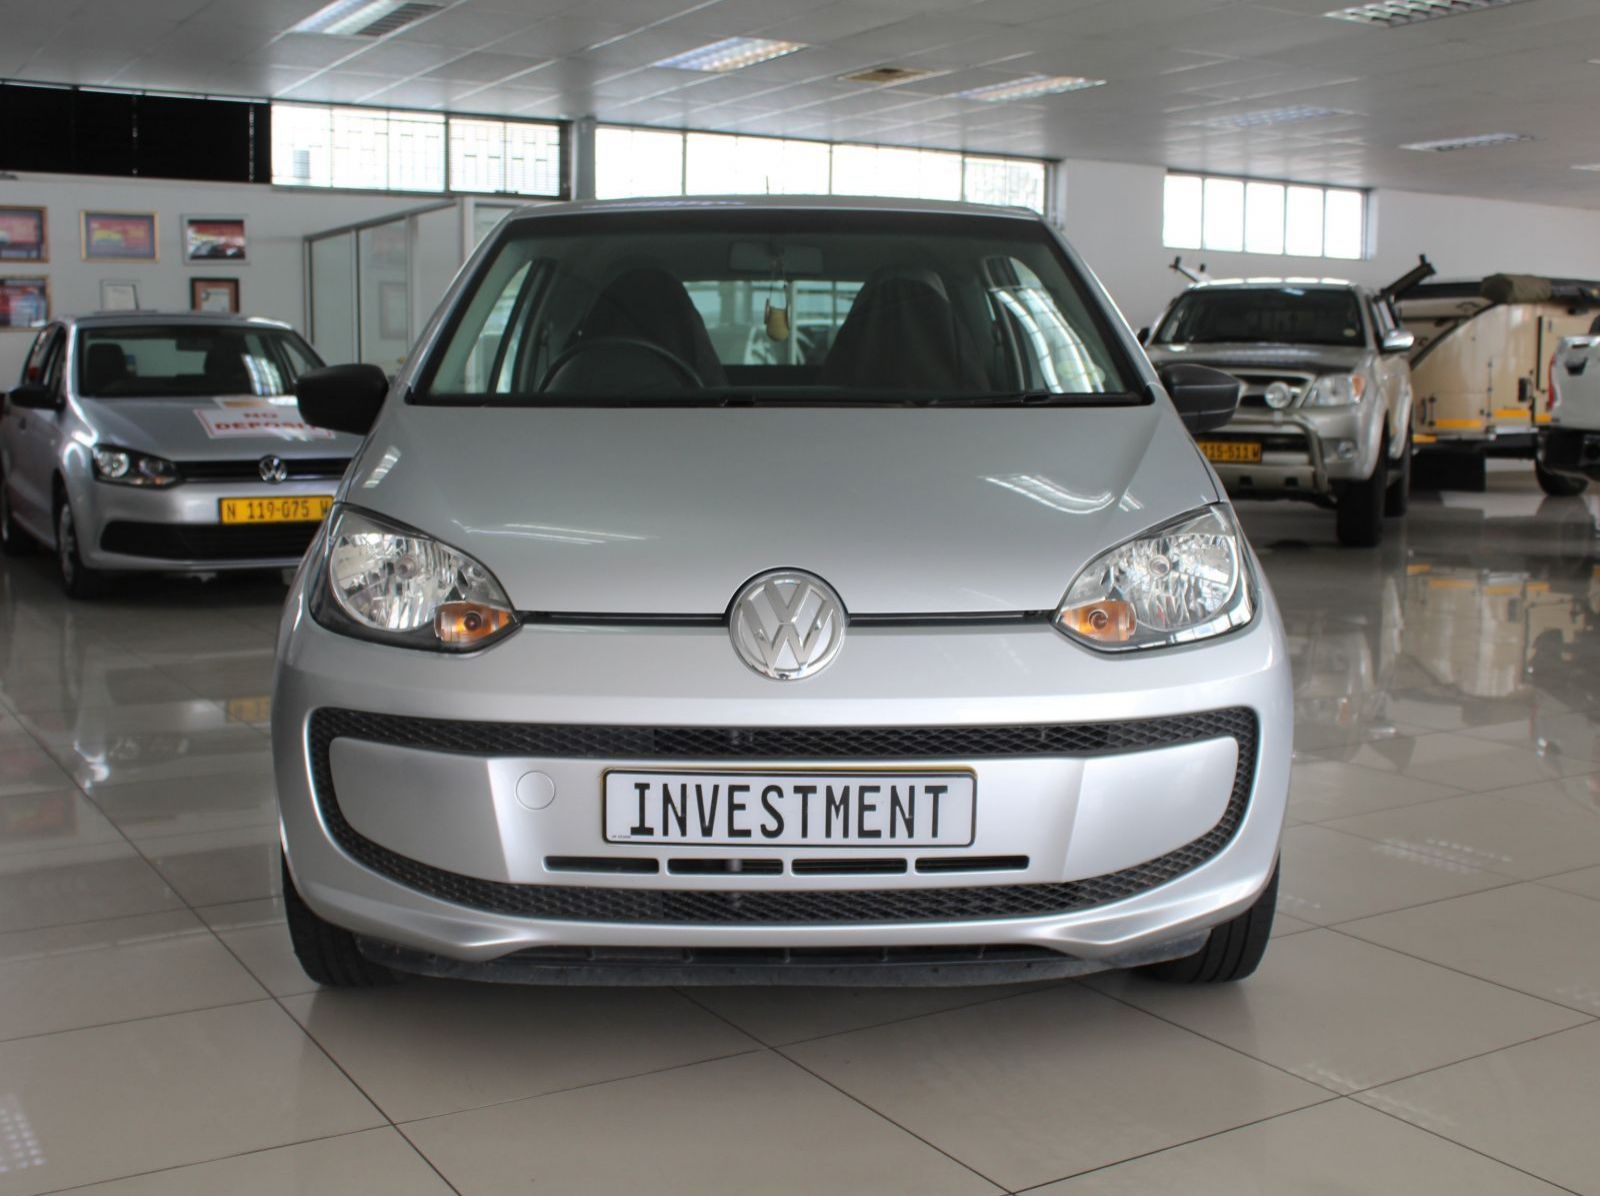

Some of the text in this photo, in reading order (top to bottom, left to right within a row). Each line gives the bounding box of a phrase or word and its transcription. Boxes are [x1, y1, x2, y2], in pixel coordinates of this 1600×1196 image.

[226, 503, 236, 521] N
[247, 500, 310, 520] 119-075
[630, 782, 949, 839] INVESTMENT
